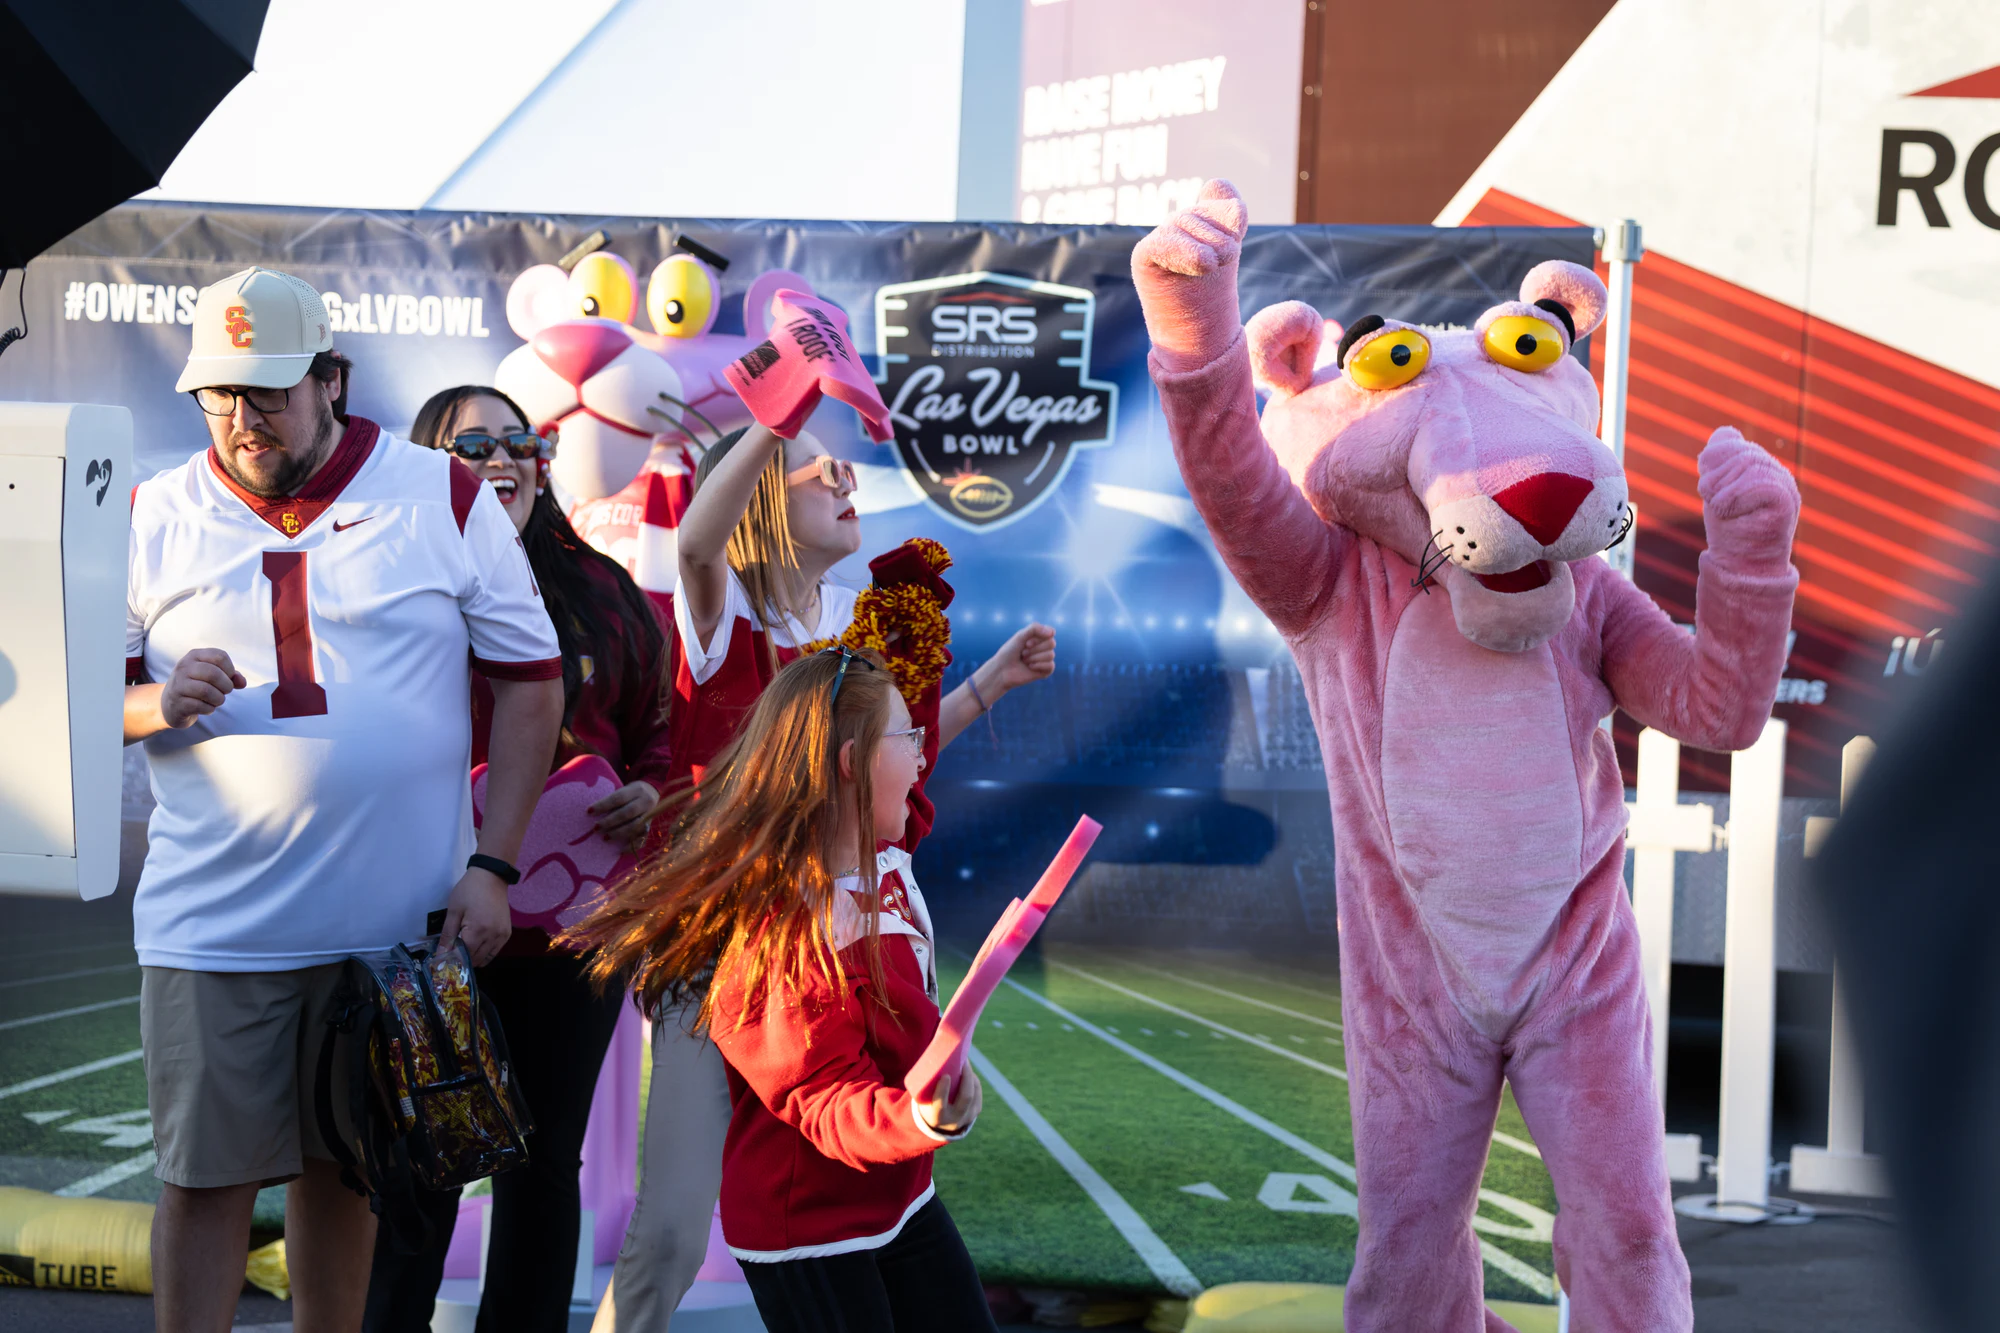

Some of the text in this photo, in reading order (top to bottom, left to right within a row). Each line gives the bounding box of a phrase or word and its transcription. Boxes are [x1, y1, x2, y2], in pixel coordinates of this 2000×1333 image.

[931, 305, 1038, 344] SRS
[931, 344, 1036, 358] DISTRIBUTION
[891, 365, 1101, 446] Las Vegas
[943, 434, 1019, 455] BOWL
[262, 551, 328, 720] 1
[40, 1263, 117, 1288] TUBE
